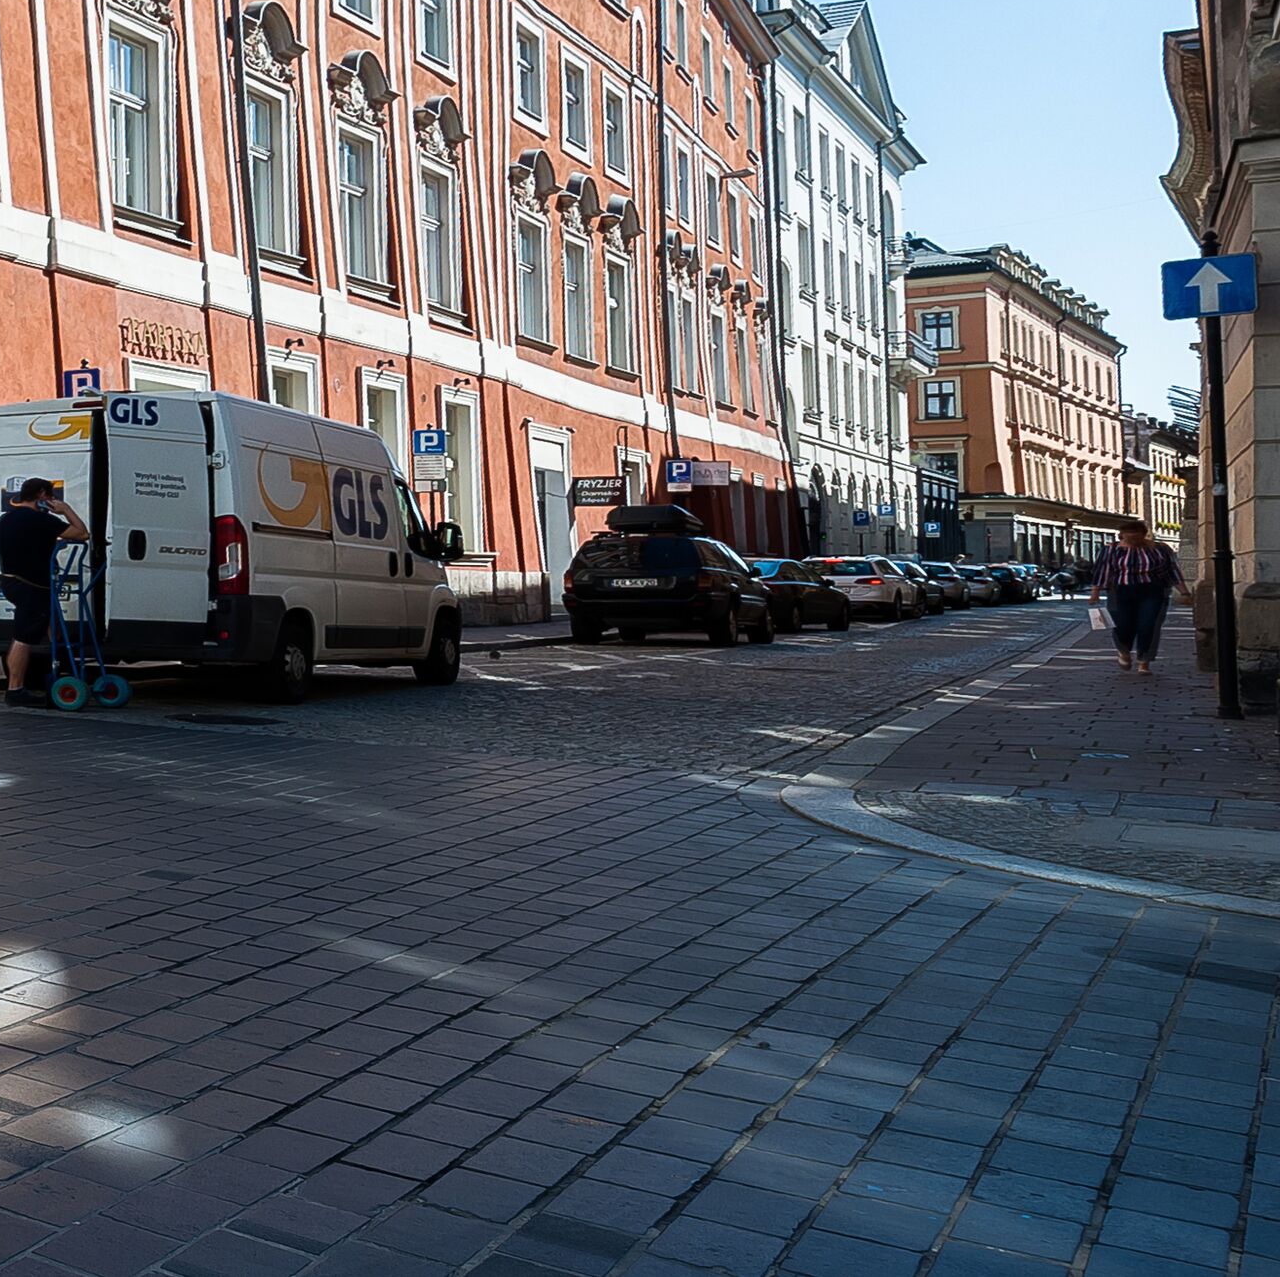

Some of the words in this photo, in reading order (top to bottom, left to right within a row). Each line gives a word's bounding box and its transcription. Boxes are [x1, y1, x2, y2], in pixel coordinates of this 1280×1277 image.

[119, 317, 207, 365] FARINA
[110, 397, 158, 426] GLS
[420, 433, 438, 452] P
[672, 463, 687, 477] P
[577, 479, 622, 488] FRYZJER
[333, 468, 388, 540] GLS
[159, 546, 207, 556] DUCATO
